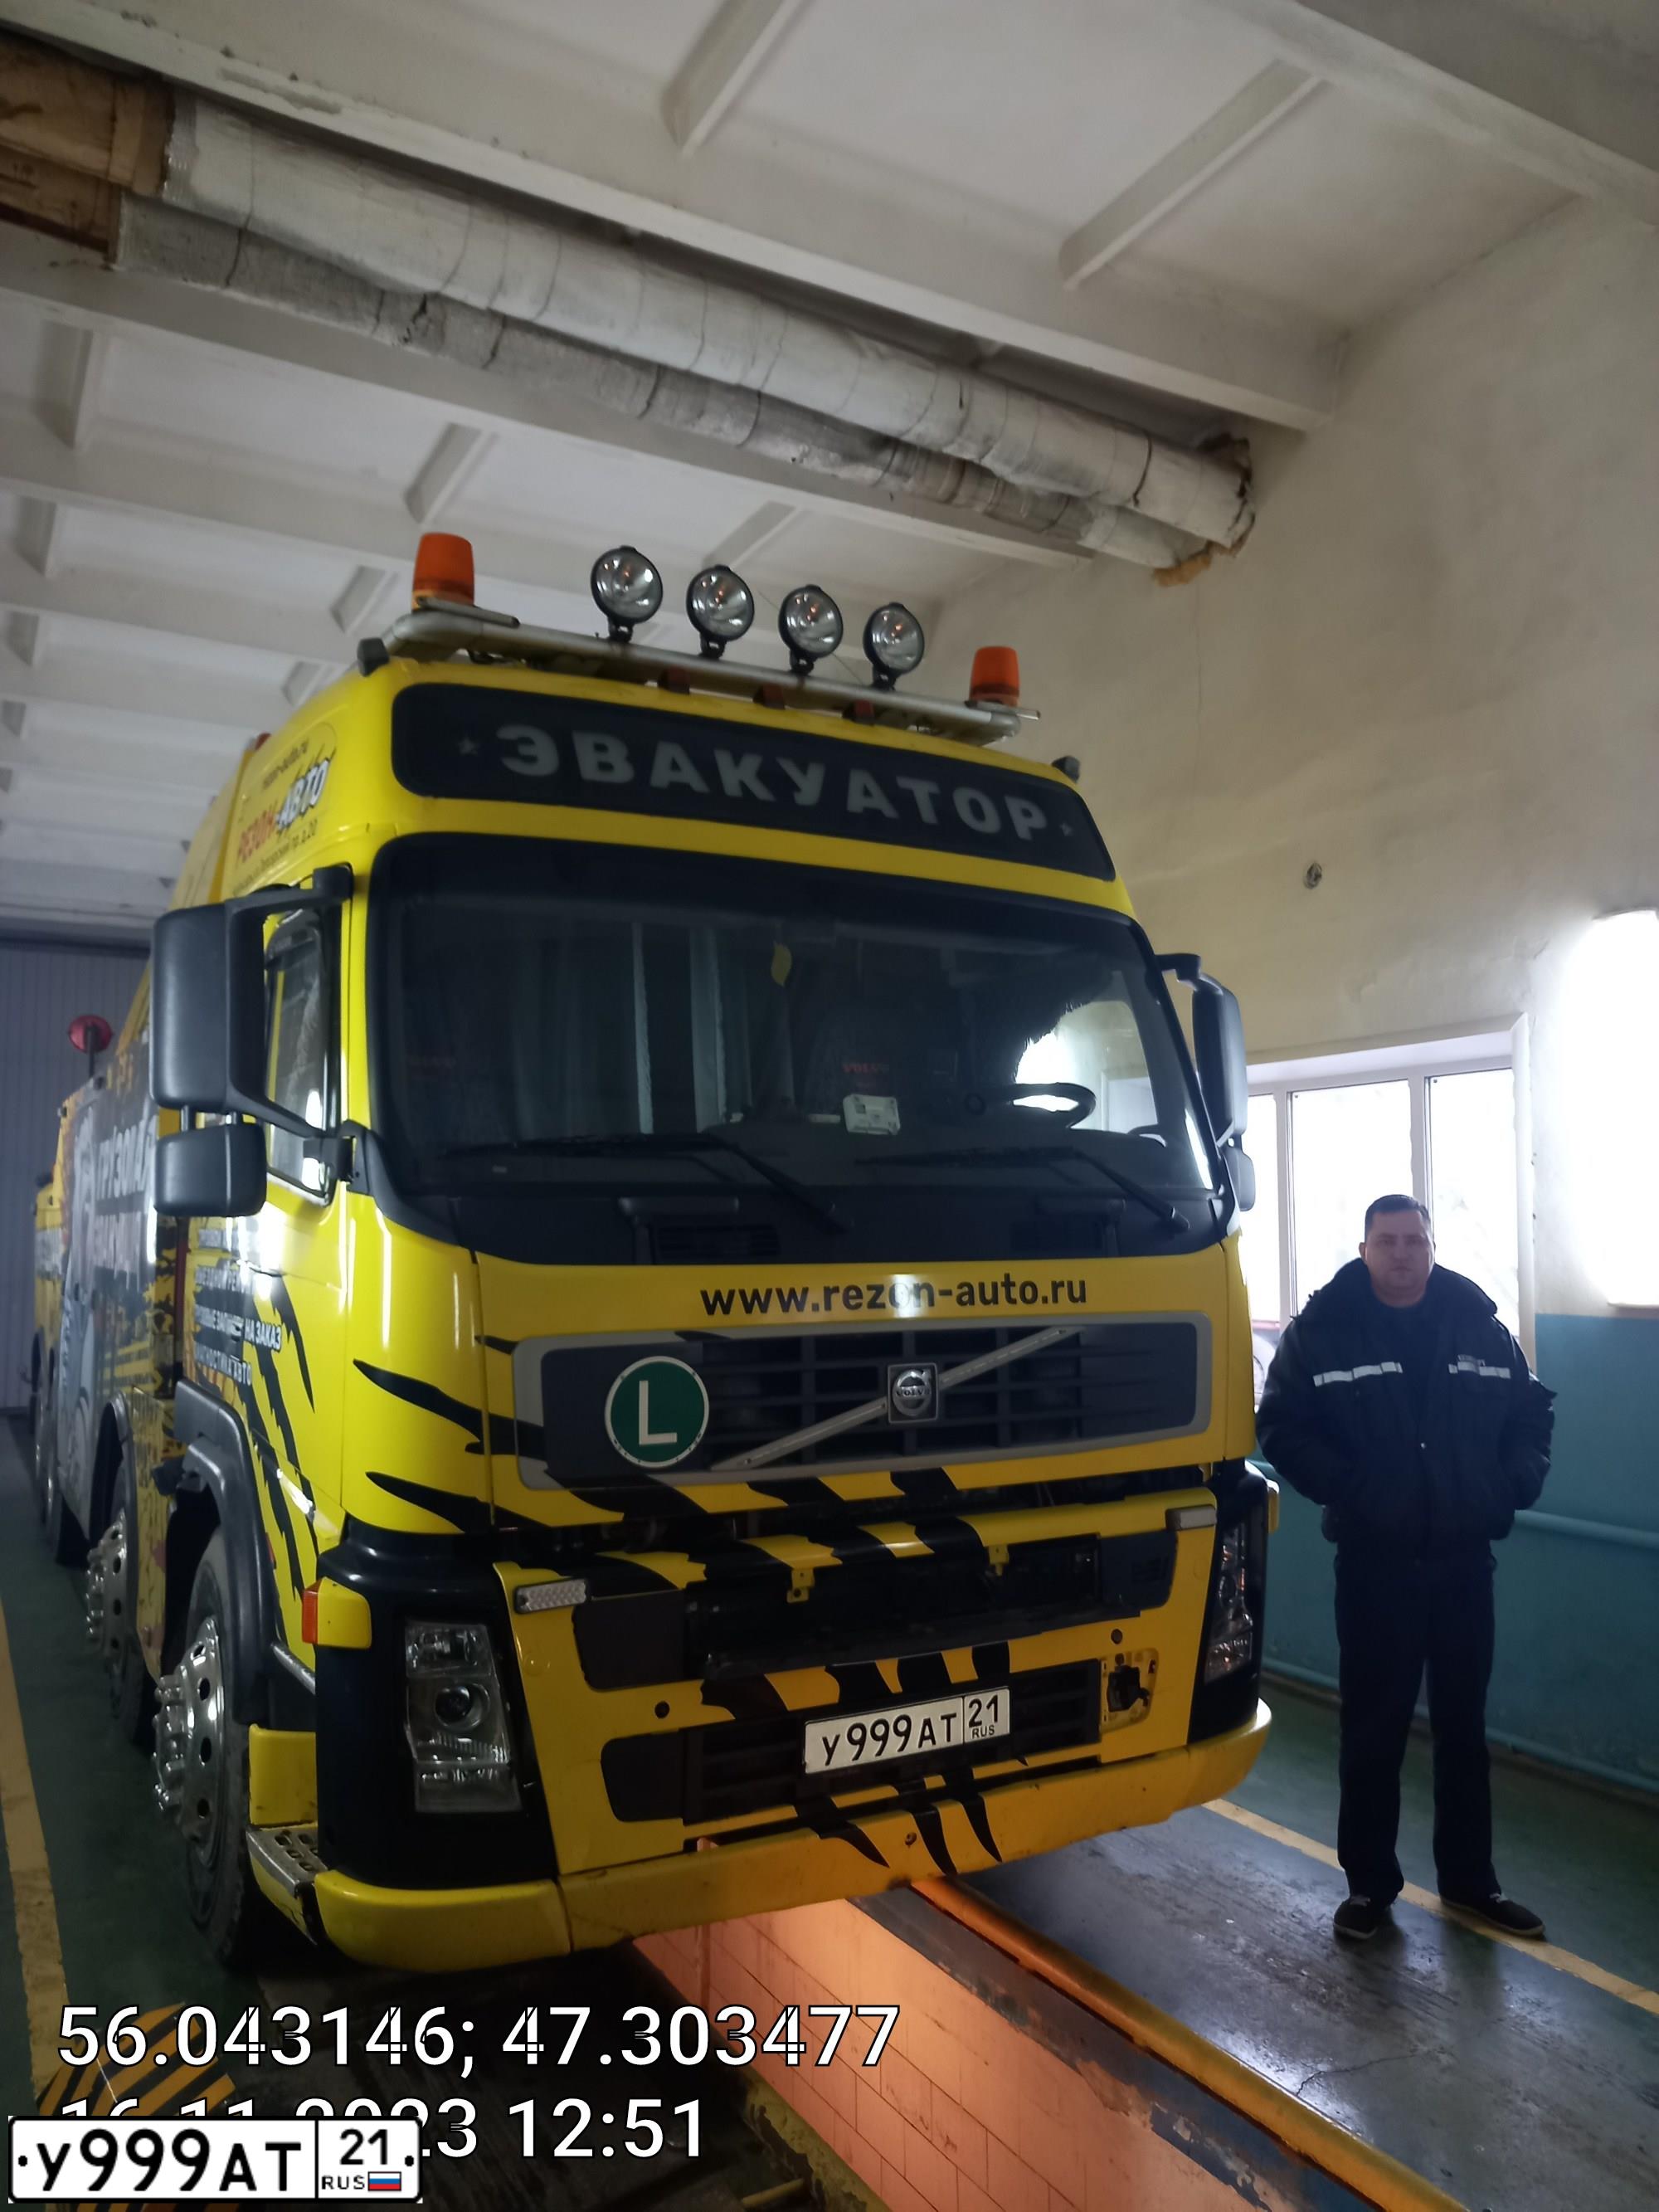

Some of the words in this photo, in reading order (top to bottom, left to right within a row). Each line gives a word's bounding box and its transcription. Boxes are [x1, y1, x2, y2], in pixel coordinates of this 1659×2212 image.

[497, 725, 1048, 840] ЭВАКУАТОР
[700, 1273, 1087, 1315] www.rezon-auto.ru
[255, 1320, 282, 1349] ЗАКАЗ
[639, 1380, 677, 1445] L
[822, 1713, 957, 1766] У999АТ
[968, 1694, 999, 1728] 21
[971, 1724, 995, 1739] RUS
